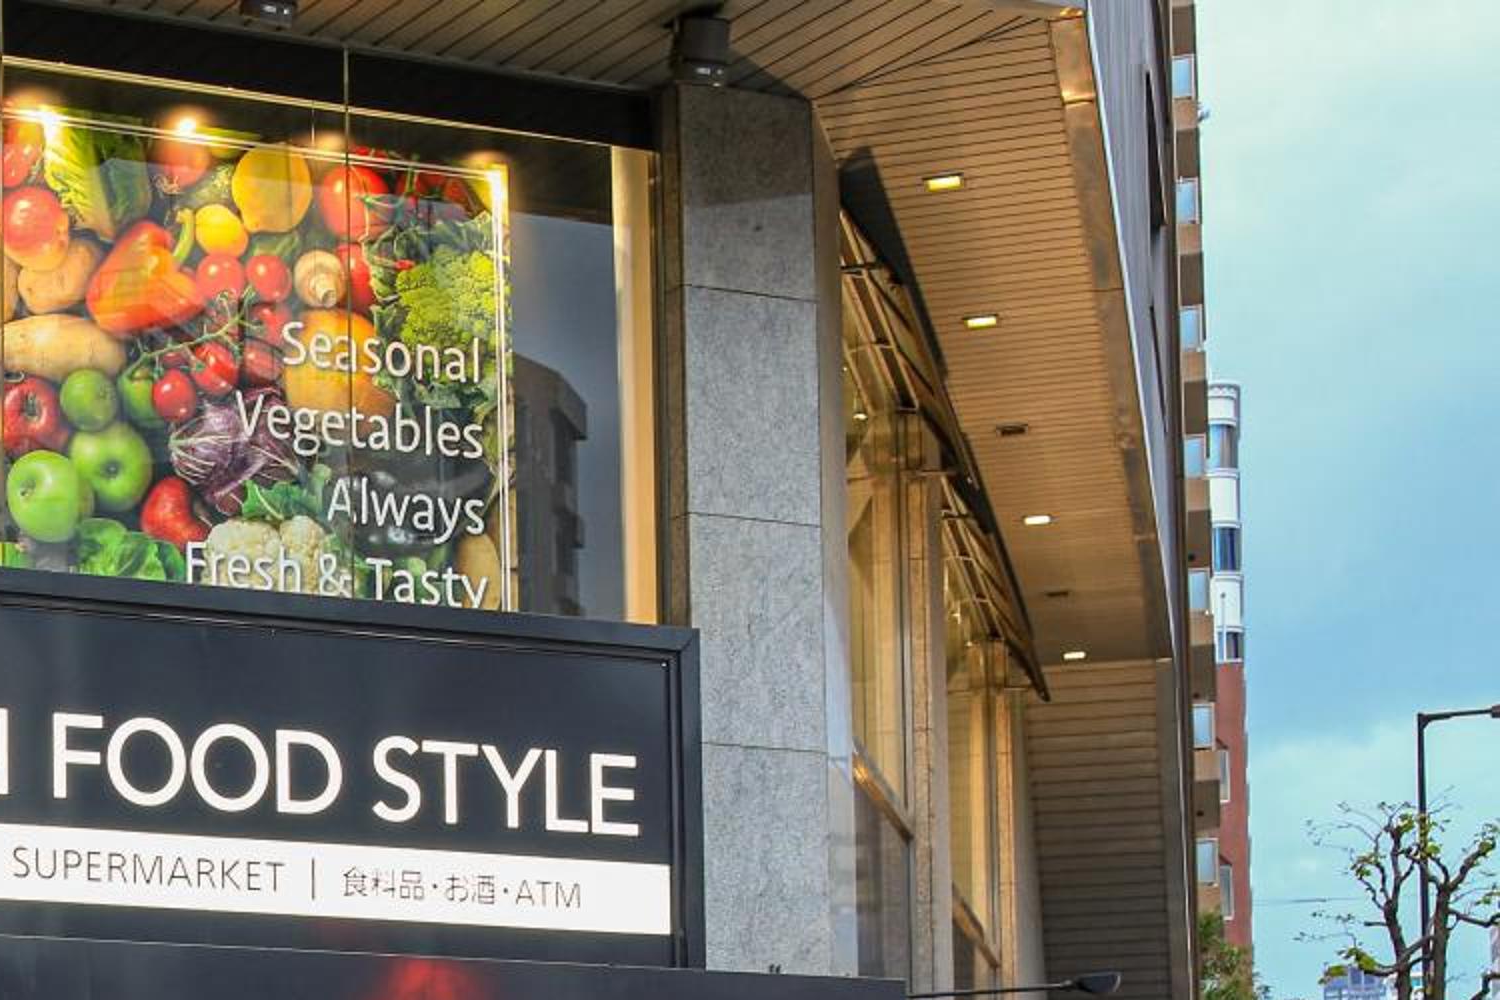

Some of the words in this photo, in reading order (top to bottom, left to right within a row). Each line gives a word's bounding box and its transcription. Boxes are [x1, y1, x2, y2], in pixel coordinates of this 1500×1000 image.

[282, 321, 480, 384] Seasonal
[236, 390, 484, 459] Vegetables
[328, 477, 485, 544] Always
[186, 542, 300, 593] Fresh
[318, 554, 352, 597] &
[366, 557, 488, 610] Tasty
[52, 711, 343, 815] FOOD
[372, 735, 640, 837] STYLE
[12, 845, 285, 893] SUPERMARKET
